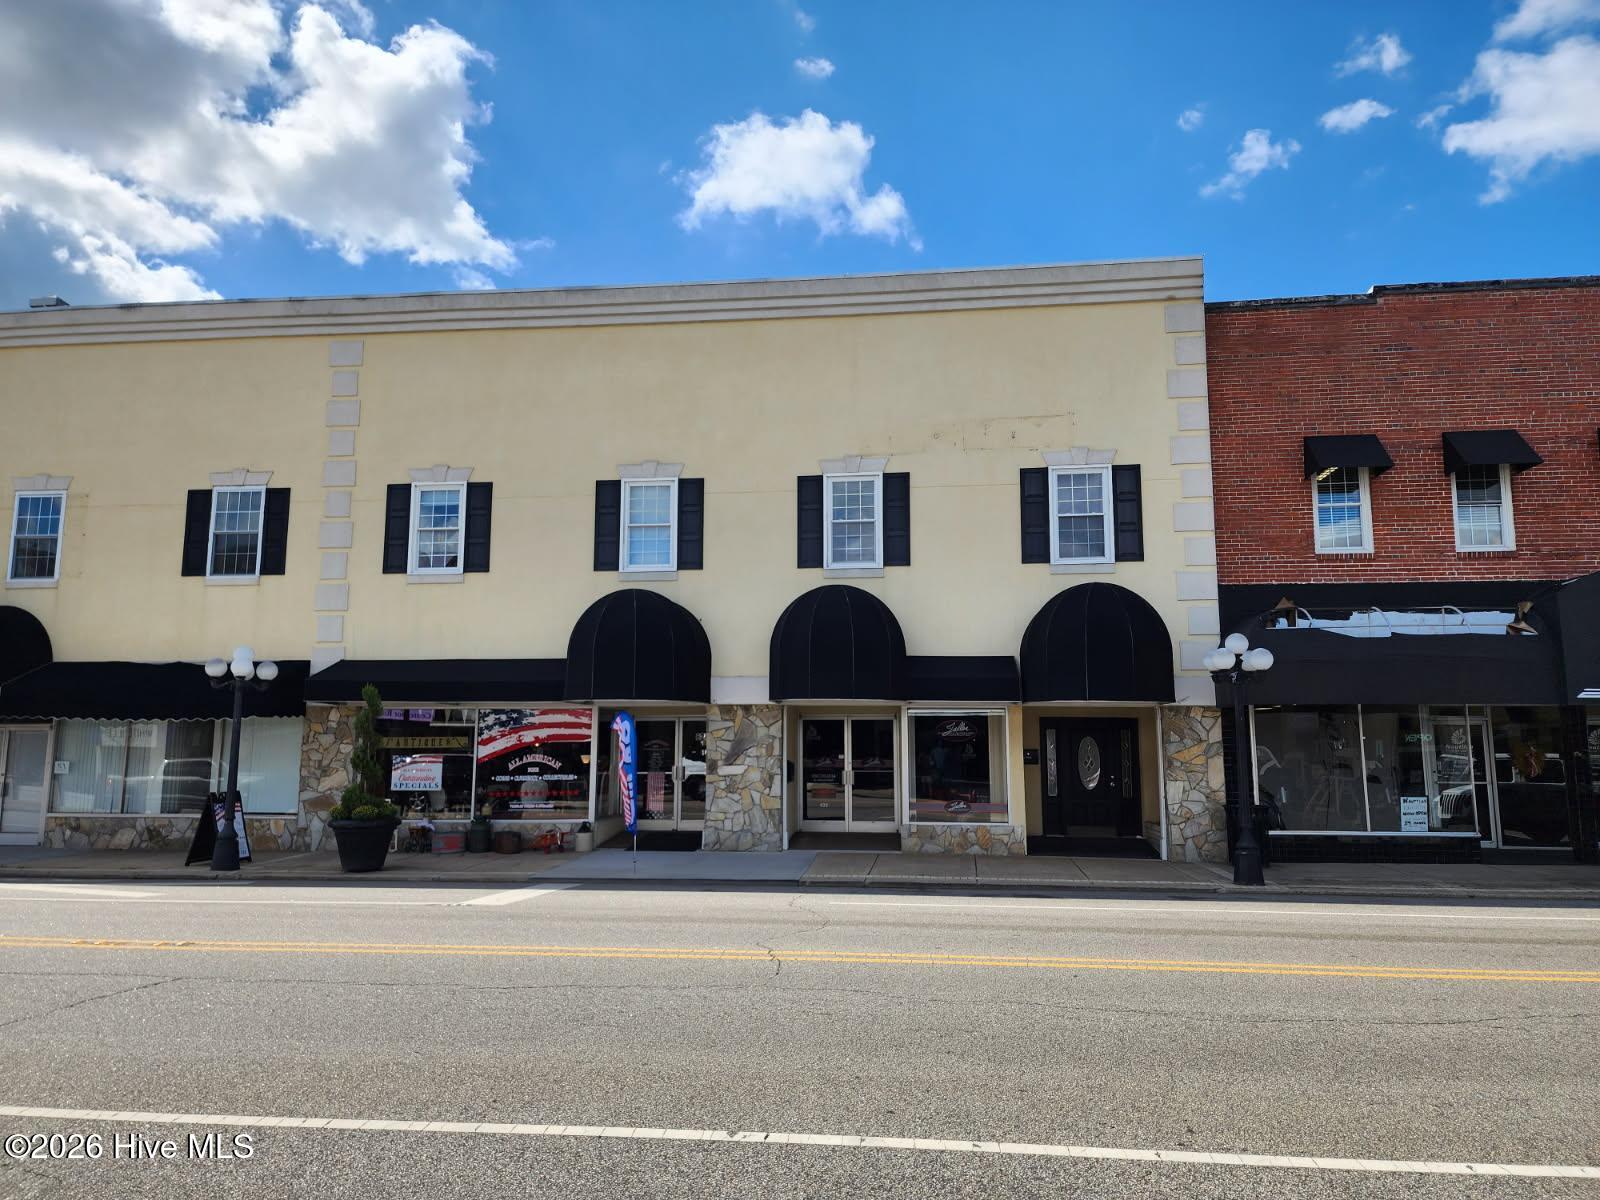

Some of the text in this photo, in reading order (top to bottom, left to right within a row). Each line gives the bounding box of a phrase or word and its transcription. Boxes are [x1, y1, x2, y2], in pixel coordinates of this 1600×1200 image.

[396, 737, 452, 747] ANTIQUES
[508, 753, 562, 771] ALL AMERICAN
